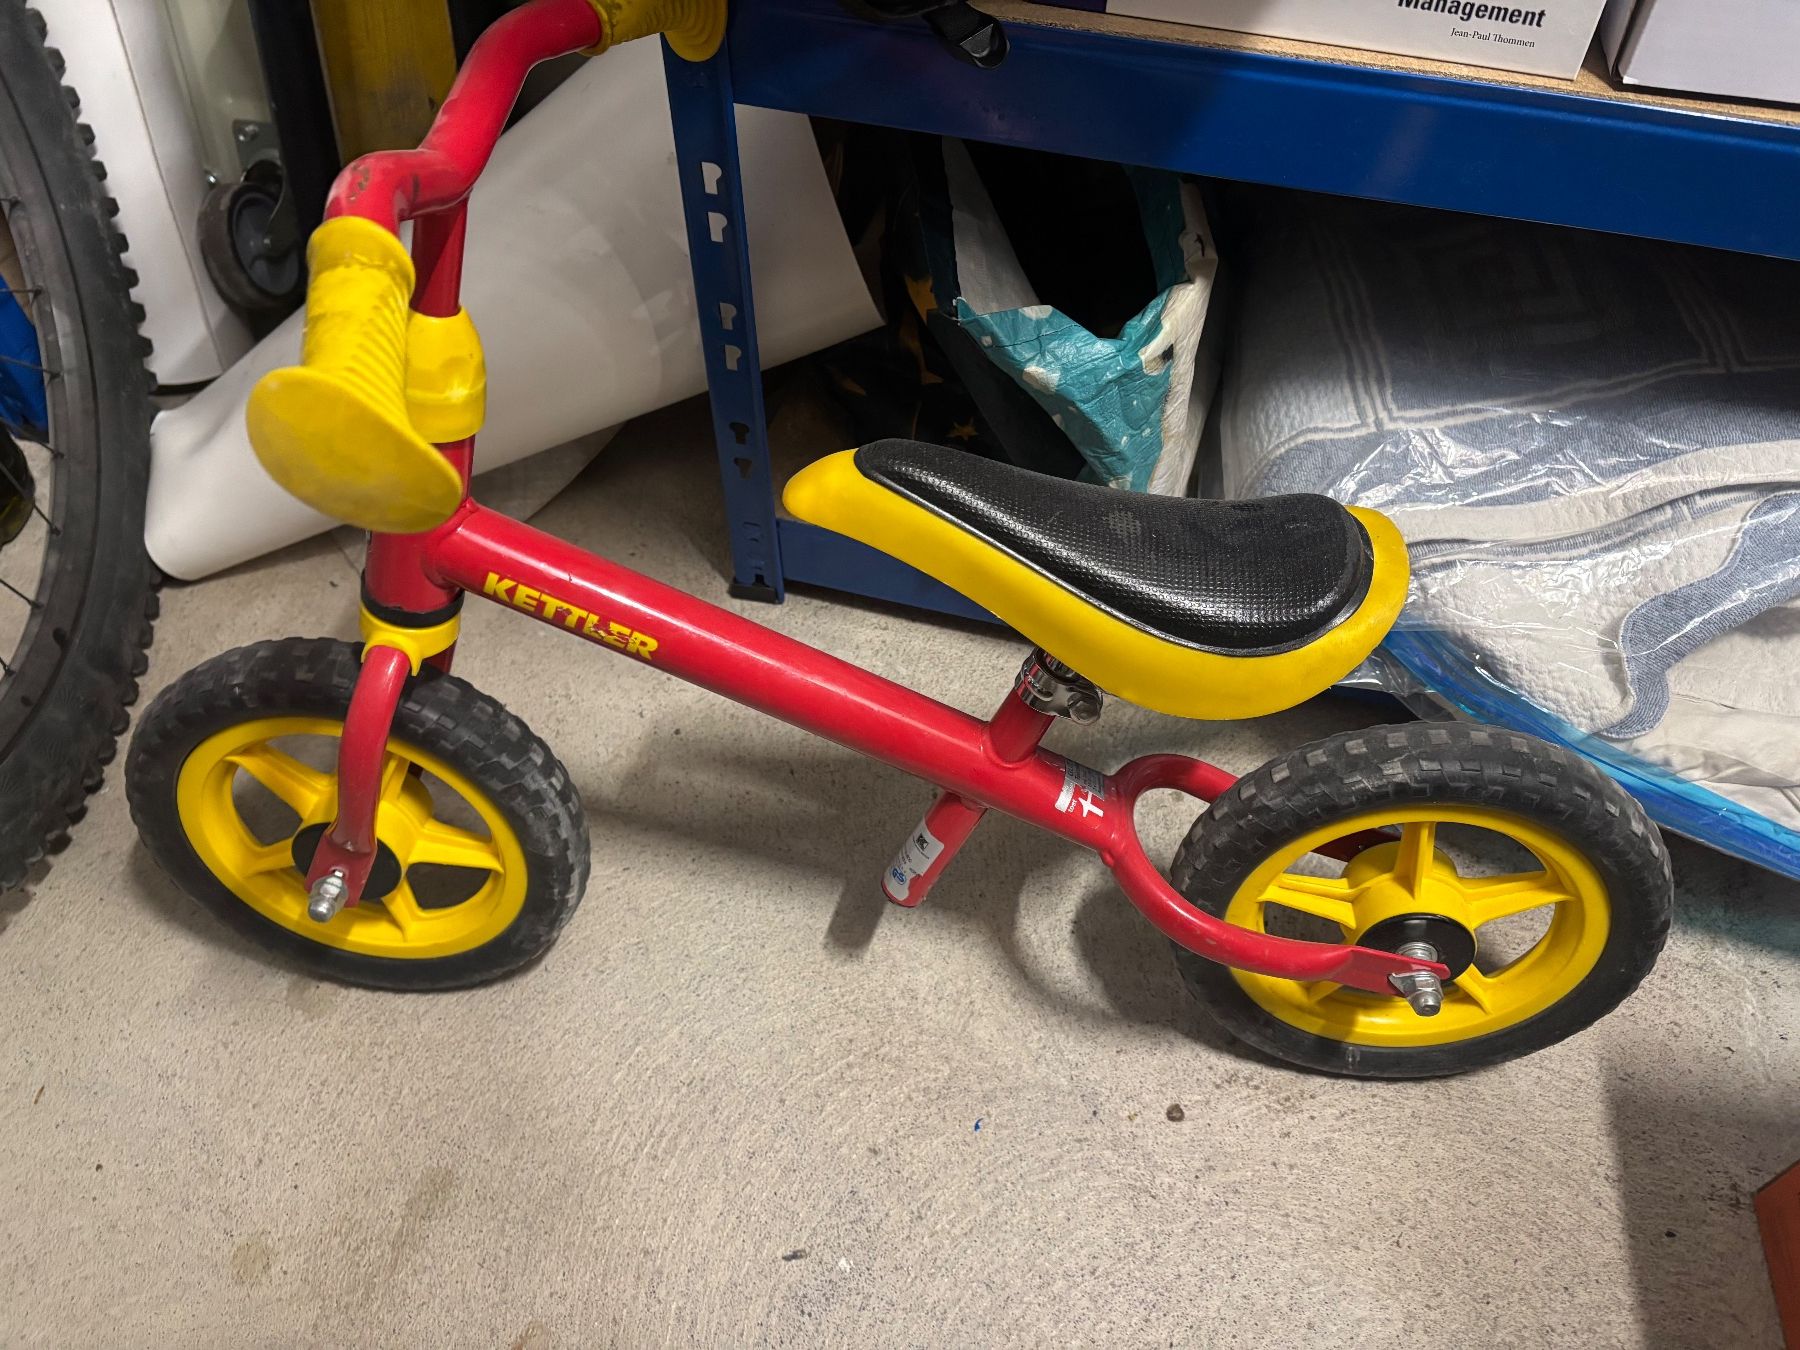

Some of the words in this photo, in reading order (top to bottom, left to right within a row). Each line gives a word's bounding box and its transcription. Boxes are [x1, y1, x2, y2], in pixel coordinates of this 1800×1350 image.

[1450, 27, 1491, 42] Jean-Paul
[1493, 33, 1536, 48] Thommen
[483, 571, 659, 660] KETTLER
